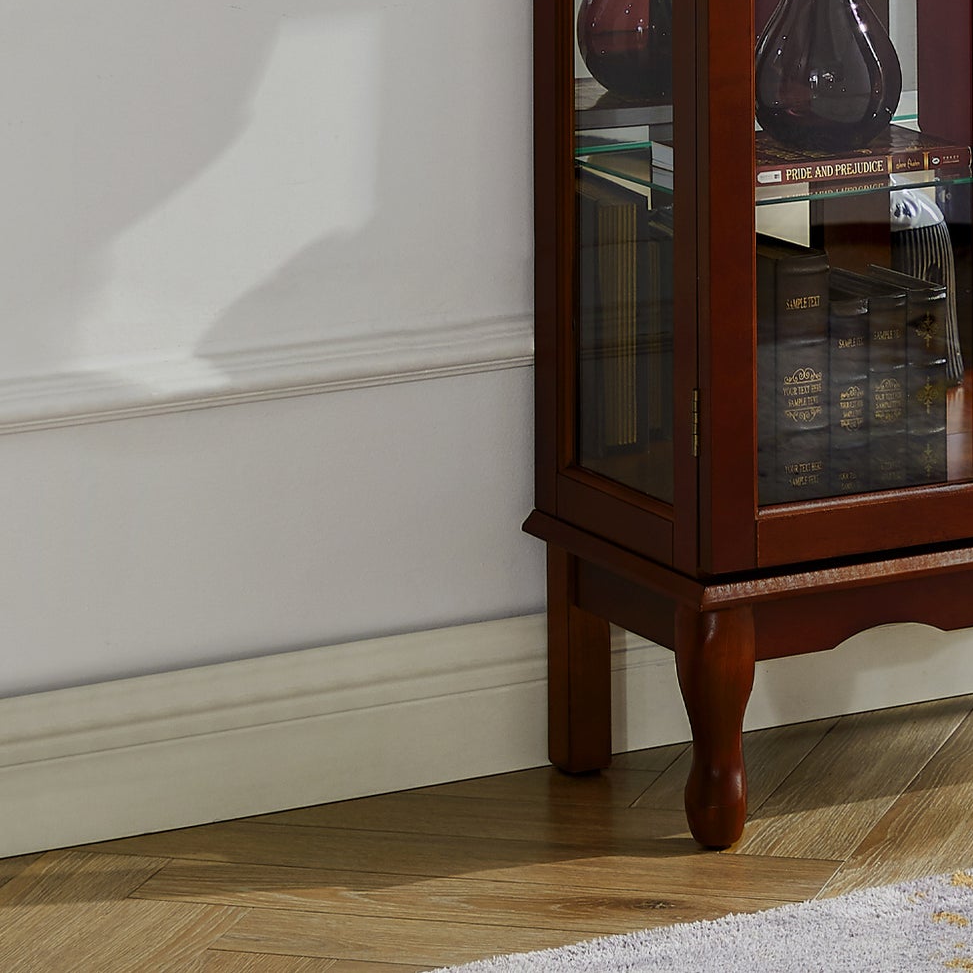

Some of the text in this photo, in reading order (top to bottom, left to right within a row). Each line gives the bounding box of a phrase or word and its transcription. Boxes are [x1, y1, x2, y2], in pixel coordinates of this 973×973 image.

[786, 160, 884, 181] PRIDE AND PREJUDICE
[786, 295, 820, 310] SAMPLE TEXT
[798, 385, 810, 394] TEXT
